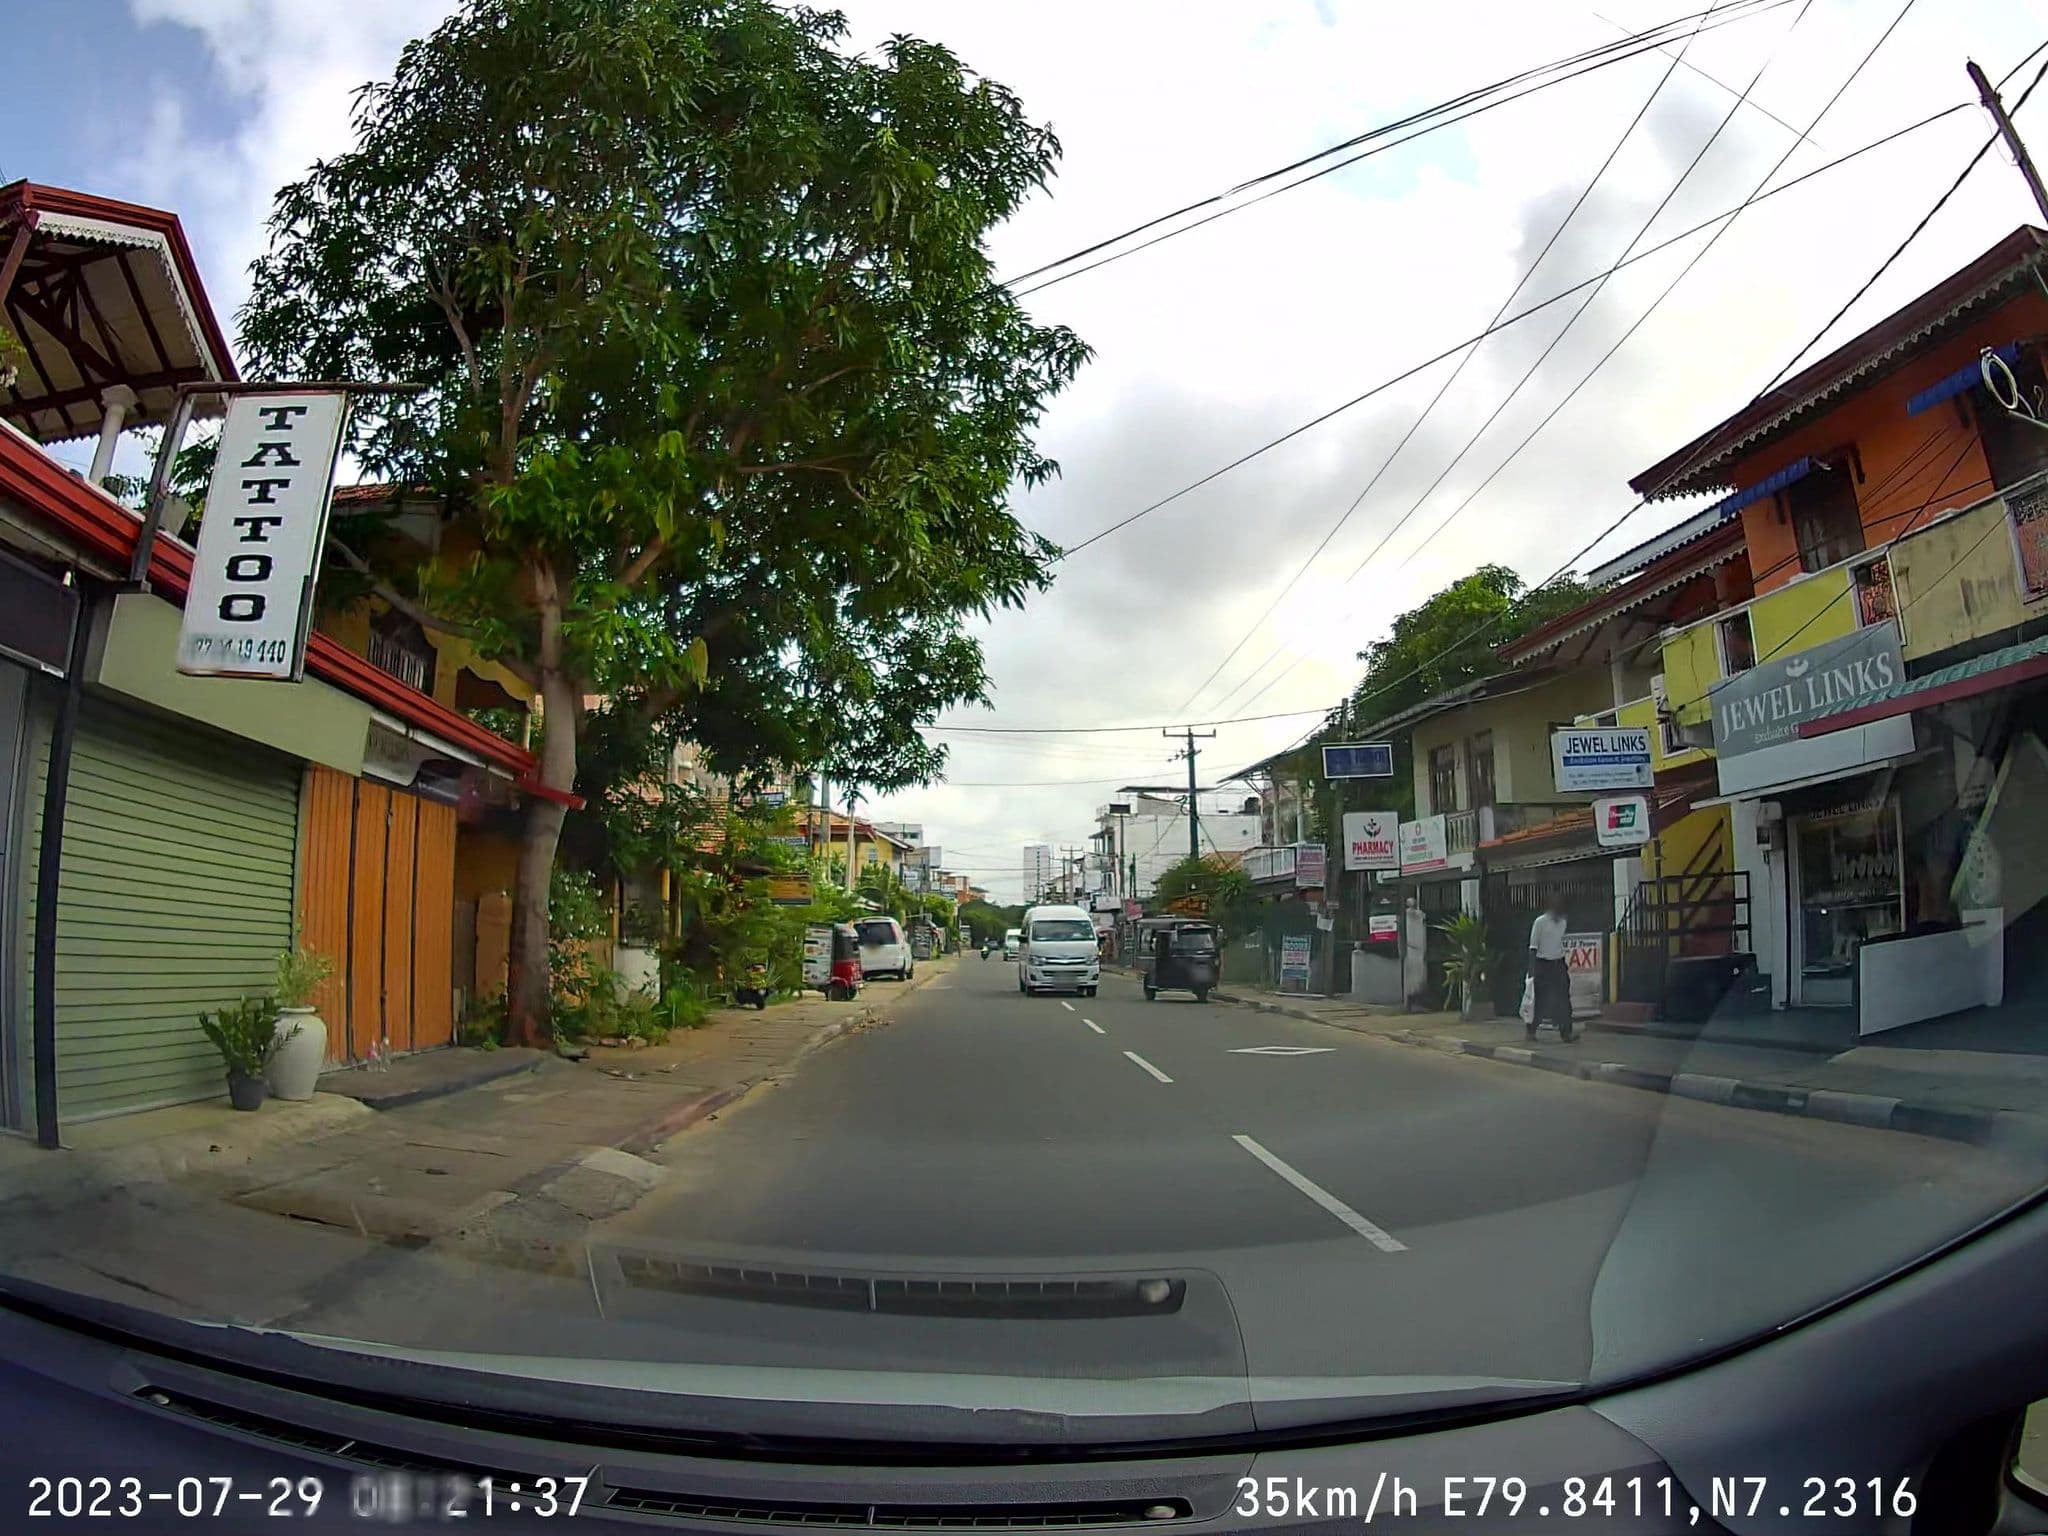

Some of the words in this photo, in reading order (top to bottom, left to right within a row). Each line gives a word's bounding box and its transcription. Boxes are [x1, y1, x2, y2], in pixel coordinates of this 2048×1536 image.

[218, 405, 308, 623] TATTOO
[1721, 683, 1803, 742] JEWEL
[1804, 651, 1894, 709] LINKS
[1566, 736, 1608, 754] JEWEL
[1611, 735, 1647, 753] LINKS
[1352, 840, 1394, 855] PHARMACY
[1566, 947, 1598, 968] AXI
